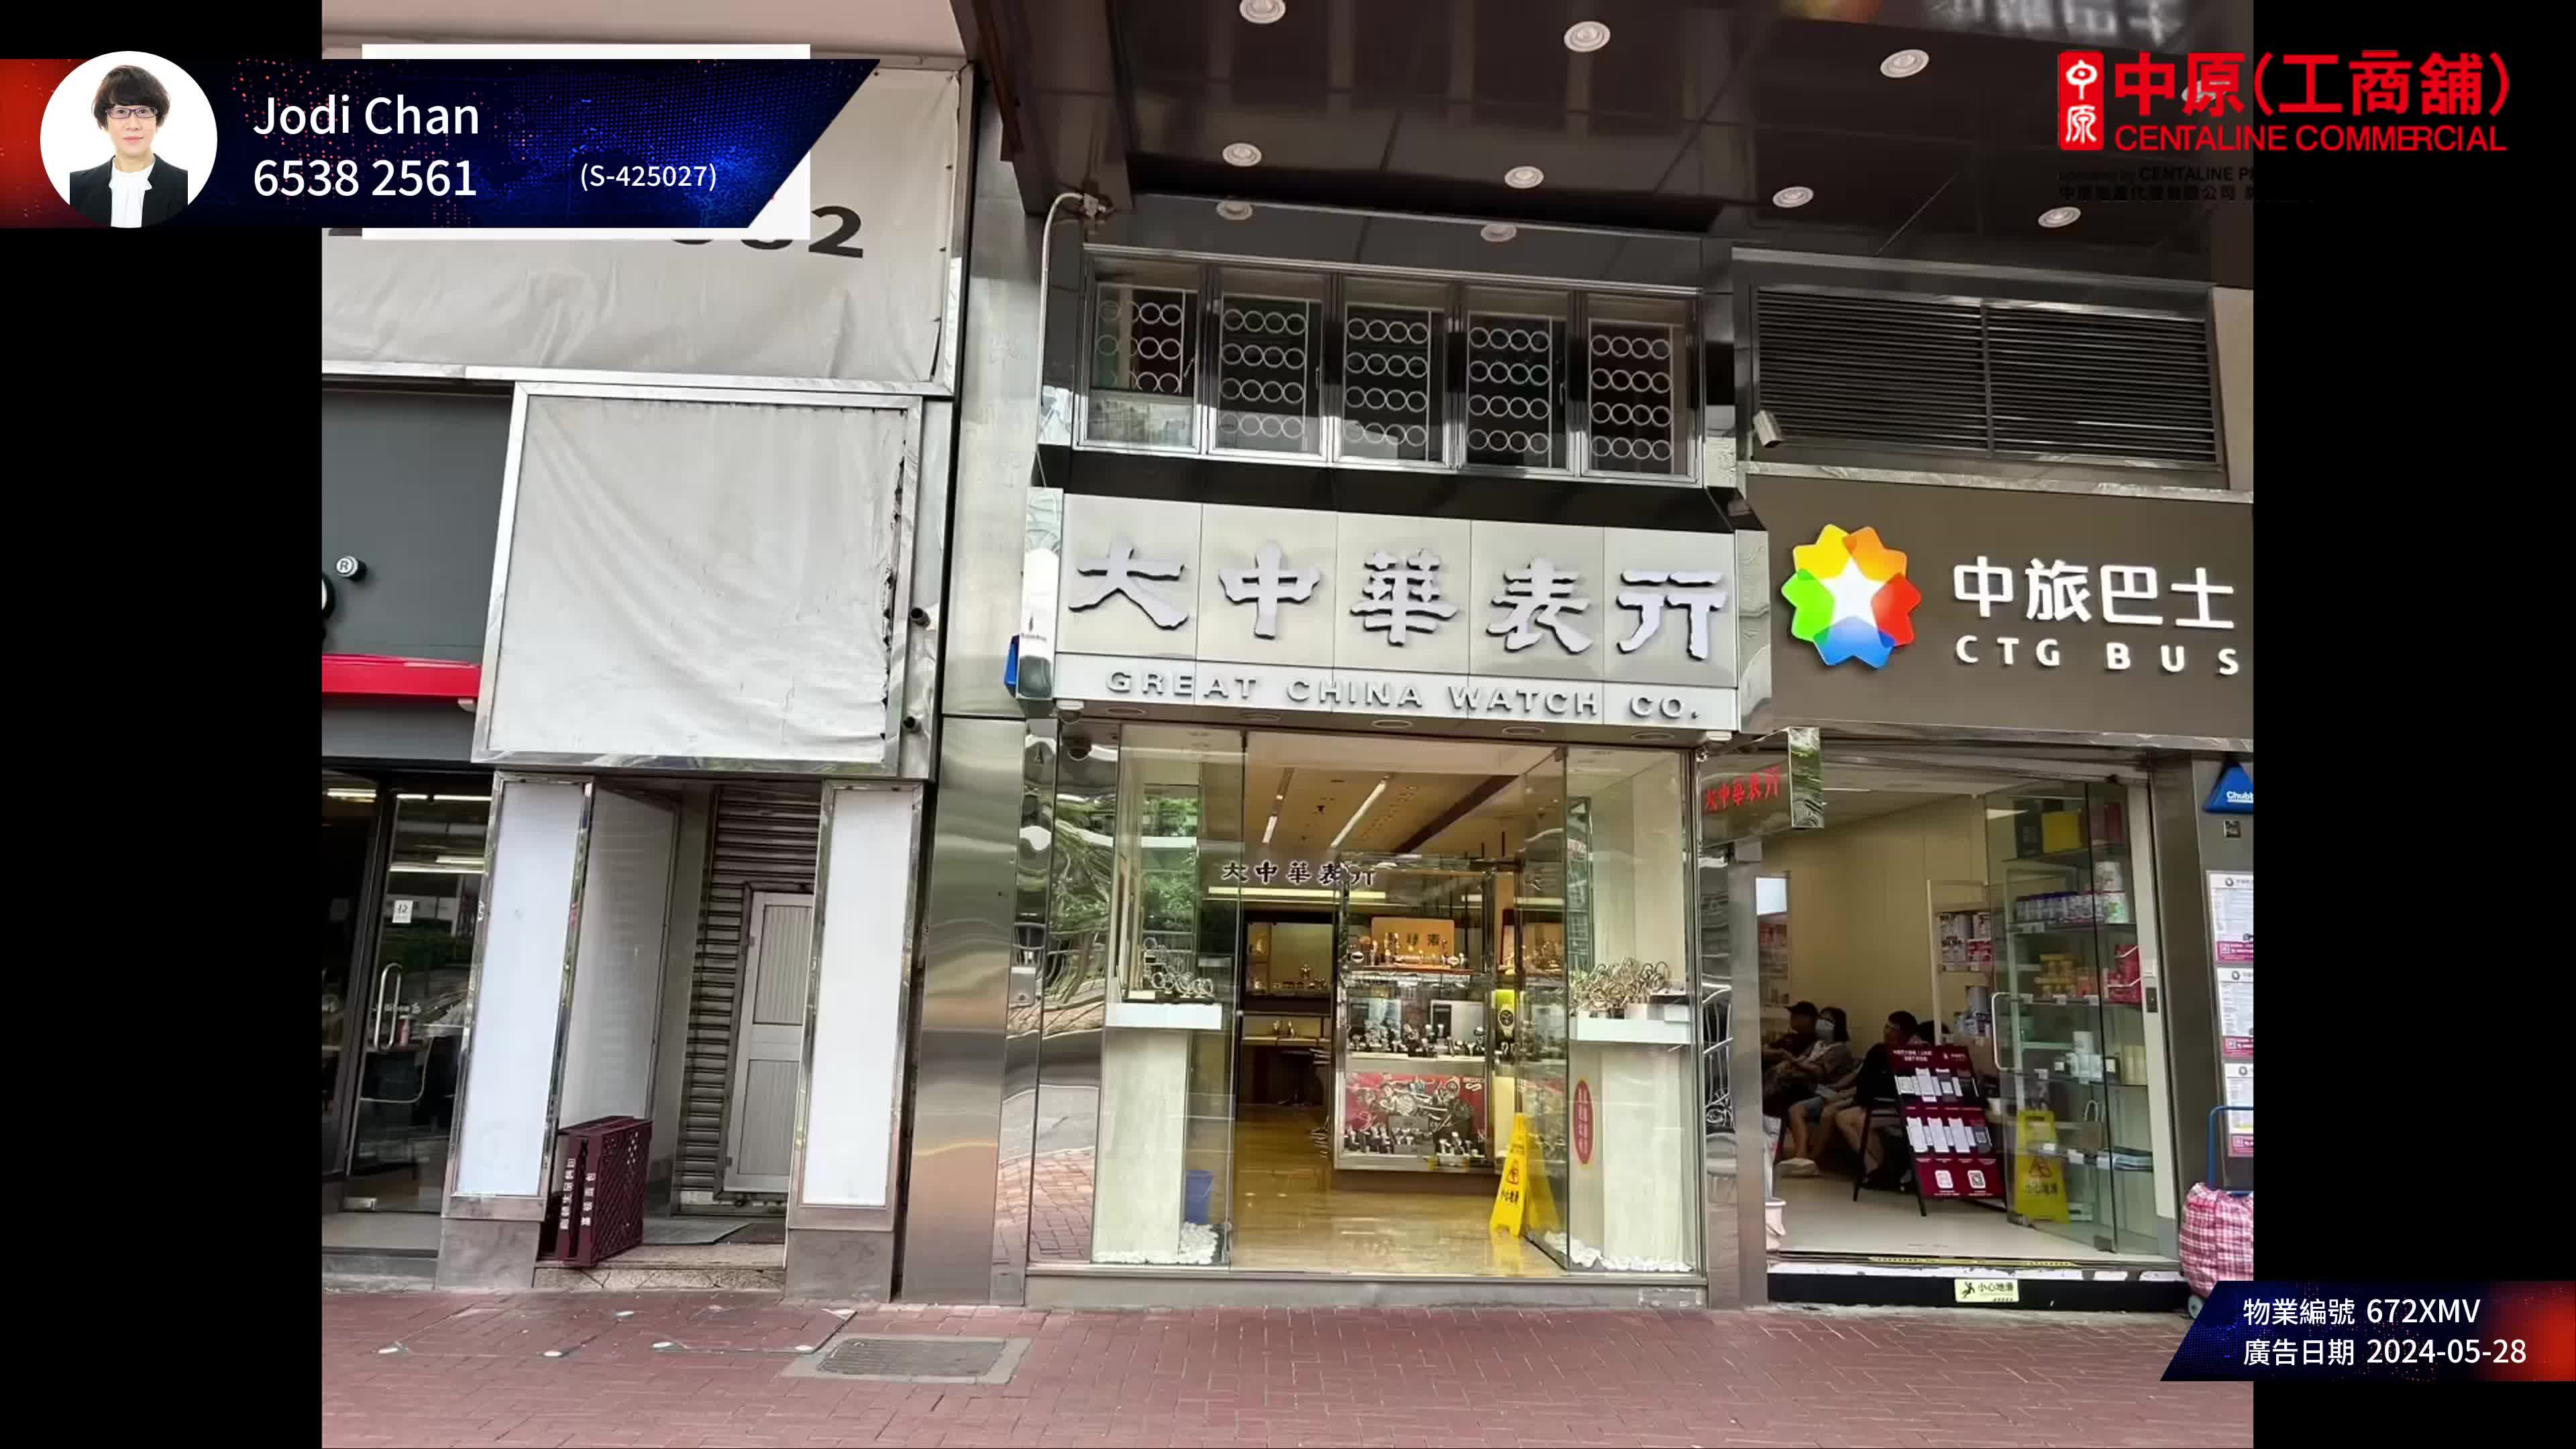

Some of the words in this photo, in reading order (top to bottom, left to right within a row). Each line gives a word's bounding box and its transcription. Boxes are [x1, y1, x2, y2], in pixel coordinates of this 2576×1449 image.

[1069, 539, 1728, 661] 大中華表行
[1953, 555, 2235, 629] 中旅巴士
[1955, 635, 2061, 667] CTG
[2106, 641, 2240, 676] BUS
[1106, 671, 1257, 699] GREAT
[1287, 680, 1424, 708] CHINA
[1448, 685, 1599, 716] WATCH
[1630, 696, 1700, 720] CO.
